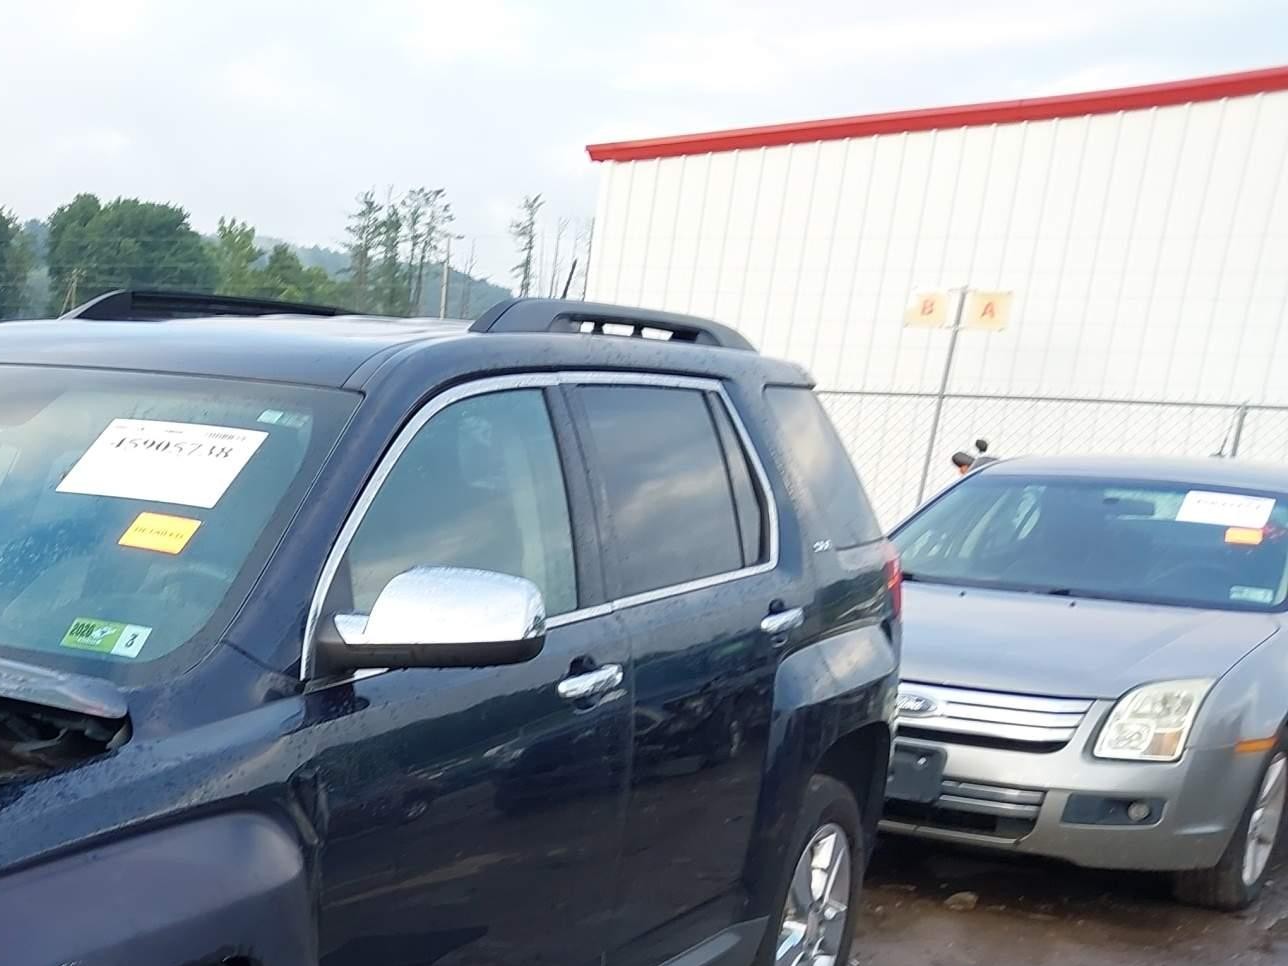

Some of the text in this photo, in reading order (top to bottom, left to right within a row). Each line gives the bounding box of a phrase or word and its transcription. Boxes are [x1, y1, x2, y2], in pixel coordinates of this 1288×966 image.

[921, 299, 935, 315] B
[981, 301, 995, 318] A
[68, 621, 97, 639] 2020
